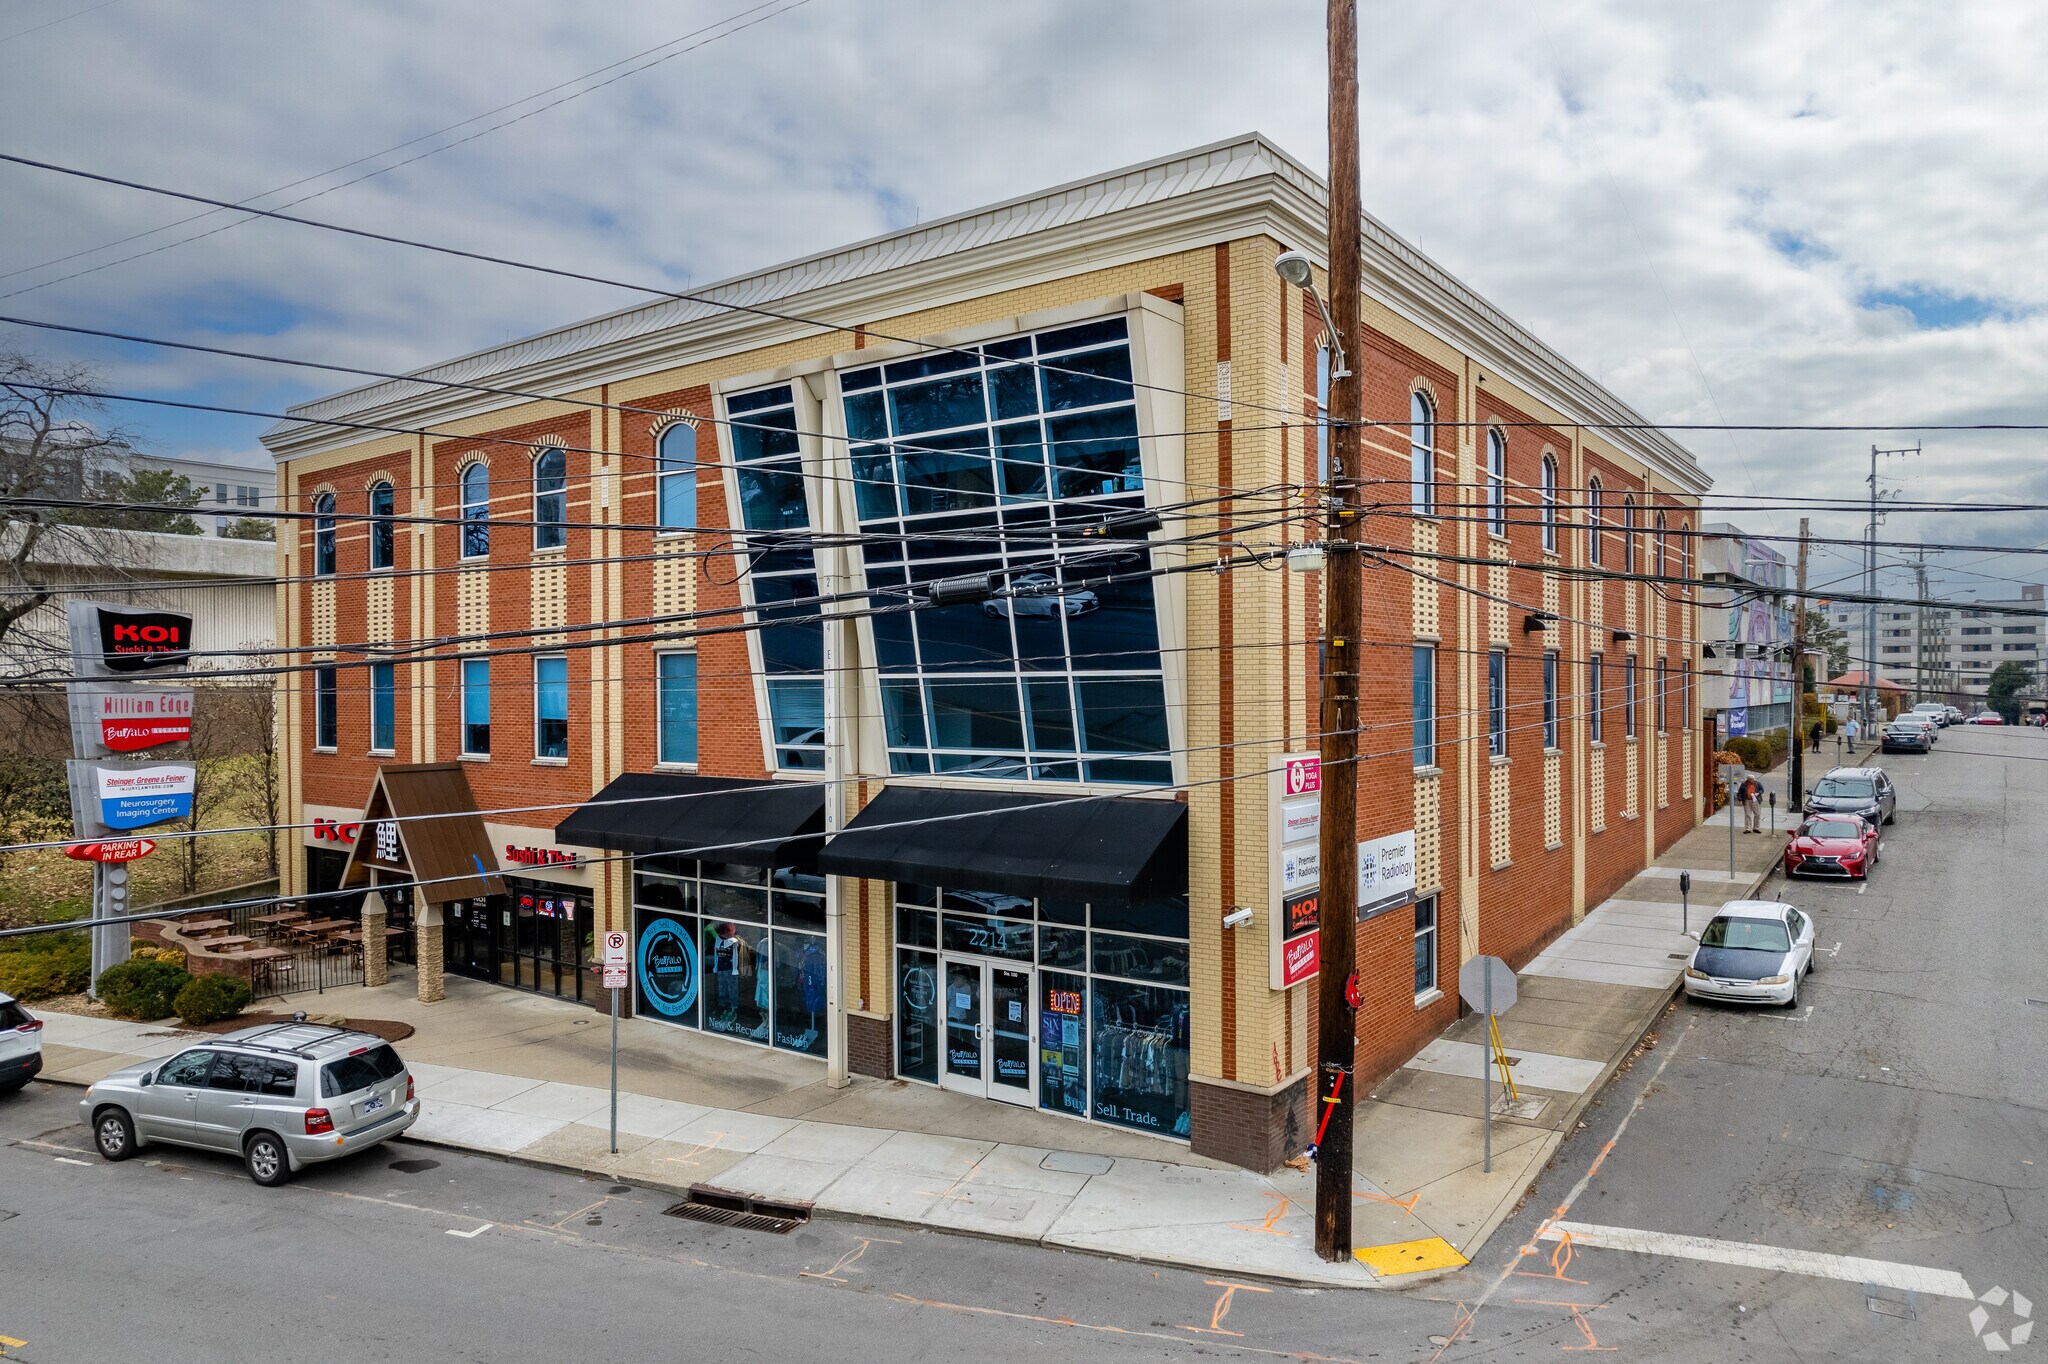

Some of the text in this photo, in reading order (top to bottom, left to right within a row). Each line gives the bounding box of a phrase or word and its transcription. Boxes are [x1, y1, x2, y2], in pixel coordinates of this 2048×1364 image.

[113, 624, 179, 643] KOI
[114, 645, 145, 653] Sushi
[147, 645, 154, 653] &
[104, 695, 189, 715] William Edge
[106, 777, 136, 787] Steinger,
[136, 775, 160, 785] Greene
[165, 774, 186, 783] Feiner
[1305, 771, 1318, 781] YOGA
[1305, 781, 1316, 790] PLUS
[116, 806, 179, 819] Imaging Center
[120, 798, 176, 809] Neurosurgery
[100, 840, 139, 853] PARKING
[375, 821, 399, 862] 鯉
[102, 849, 138, 861] IN REAR
[505, 845, 536, 864] Sushi
[537, 848, 550, 865] &
[1298, 854, 1317, 867] Premier
[1381, 844, 1407, 863] Premier
[1381, 860, 1413, 881] Radiology
[1291, 897, 1318, 920] KOI
[969, 929, 1008, 951] 2214
[1053, 992, 1078, 1012] OPEN
[708, 1016, 726, 1030] New
[726, 1021, 734, 1032] &
[735, 1022, 769, 1039] Recycled
[1096, 1102, 1120, 1118] Sell.
[1122, 1107, 1160, 1127] Trade.
